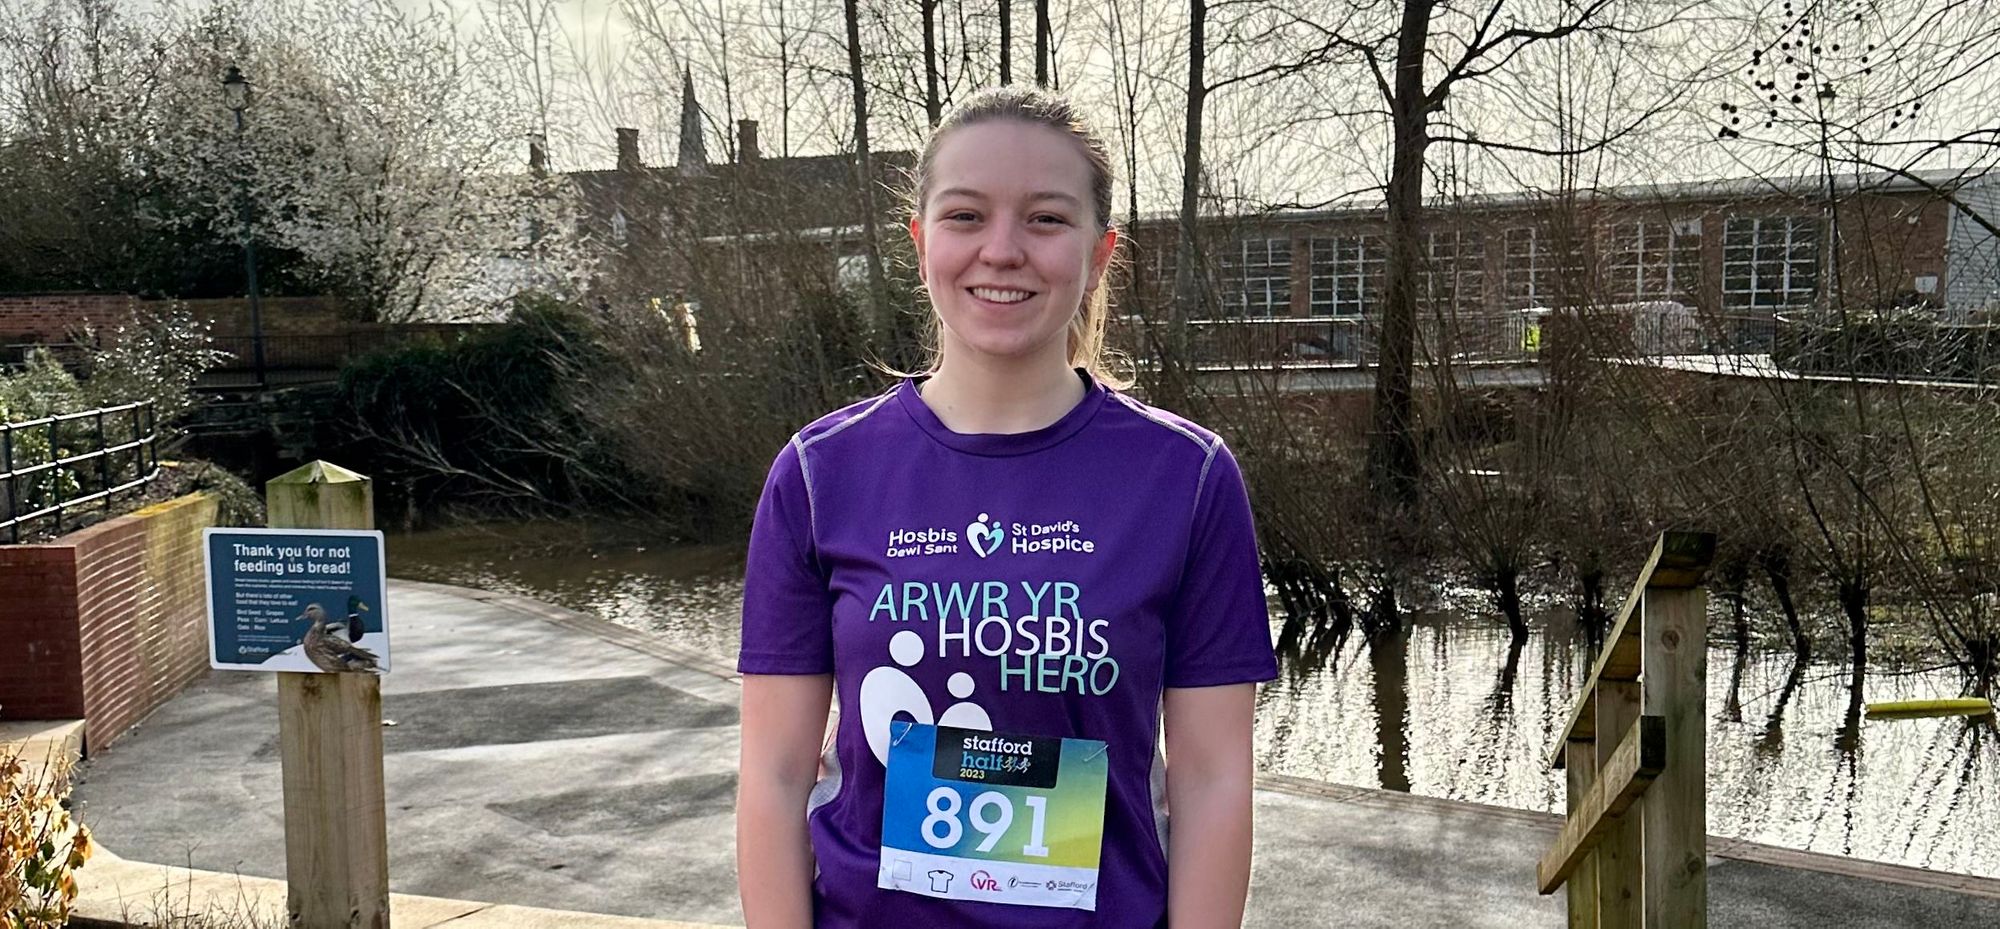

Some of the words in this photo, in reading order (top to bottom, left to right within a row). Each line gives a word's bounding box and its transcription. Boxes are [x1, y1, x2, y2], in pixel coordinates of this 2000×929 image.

[889, 528, 957, 547] Hosbis
[1012, 523, 1027, 536] St
[1031, 520, 1080, 536] David's
[233, 544, 274, 557] Thank
[277, 546, 302, 560] you
[305, 545, 325, 557] for
[329, 546, 350, 558] not
[887, 545, 920, 557] Dewi
[924, 544, 958, 555] Sant
[1012, 535, 1095, 554] Hospice
[234, 560, 283, 576] feeding
[288, 564, 304, 573] us
[308, 561, 351, 574] bread!
[869, 581, 1009, 622] ARWR
[1021, 581, 1081, 619] YR
[939, 615, 1109, 660] HOSBIS
[1000, 654, 1120, 696] HERO
[963, 735, 1033, 756] stafford
[961, 751, 1003, 771] half
[960, 768, 985, 780] 2023
[920, 786, 1049, 857] 891
[1058, 881, 1088, 890] Stafford
